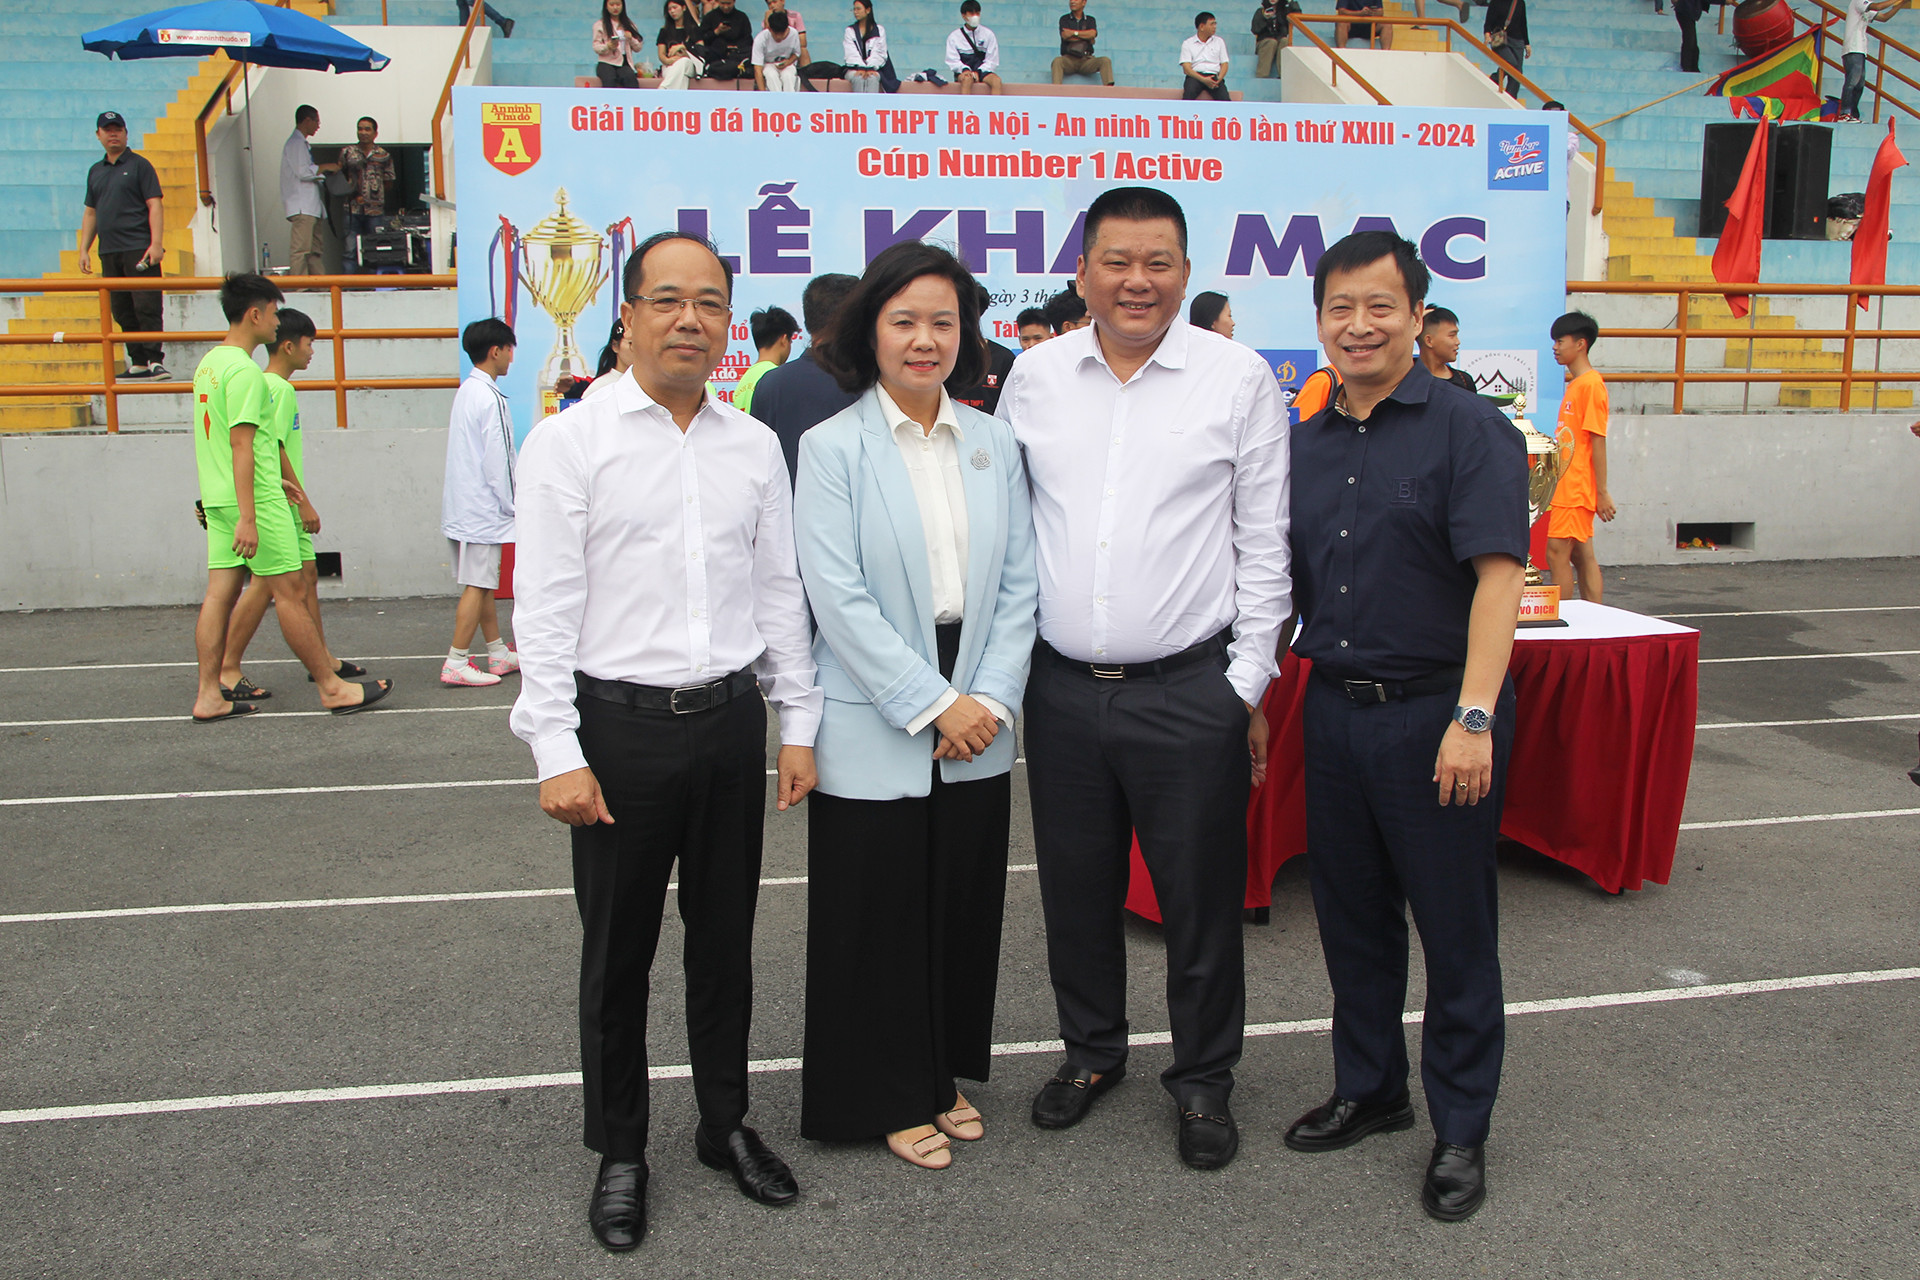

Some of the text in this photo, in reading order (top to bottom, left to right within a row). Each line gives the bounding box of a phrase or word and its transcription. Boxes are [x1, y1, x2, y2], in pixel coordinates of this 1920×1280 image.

[571, 103, 624, 131] Giải
[633, 106, 701, 135] bóng
[710, 107, 743, 133] đá
[752, 108, 802, 137] học
[810, 109, 868, 134] sinh
[875, 110, 939, 134] THPT
[948, 110, 981, 135] Hà
[989, 111, 1030, 140] Nội
[1054, 112, 1086, 137] An
[1095, 114, 1150, 138] ninh
[1158, 114, 1203, 140] Thủ
[1211, 117, 1242, 141] đô
[1250, 114, 1288, 142] lần
[1295, 119, 1337, 143] thứ
[1342, 121, 1395, 145] XXIII
[1418, 122, 1476, 147] 2024
[493, 128, 532, 163] A
[858, 147, 1223, 181] Cúp Number 1 Active
[1493, 160, 1545, 181] ACTIVE
[1225, 213, 1486, 281] MC
[988, 289, 1016, 307] gày
[1020, 289, 1030, 303] 3
[731, 320, 748, 340] tổ
[1398, 481, 1411, 498] B
[1519, 604, 1555, 617] VÔ ĐỊCH
